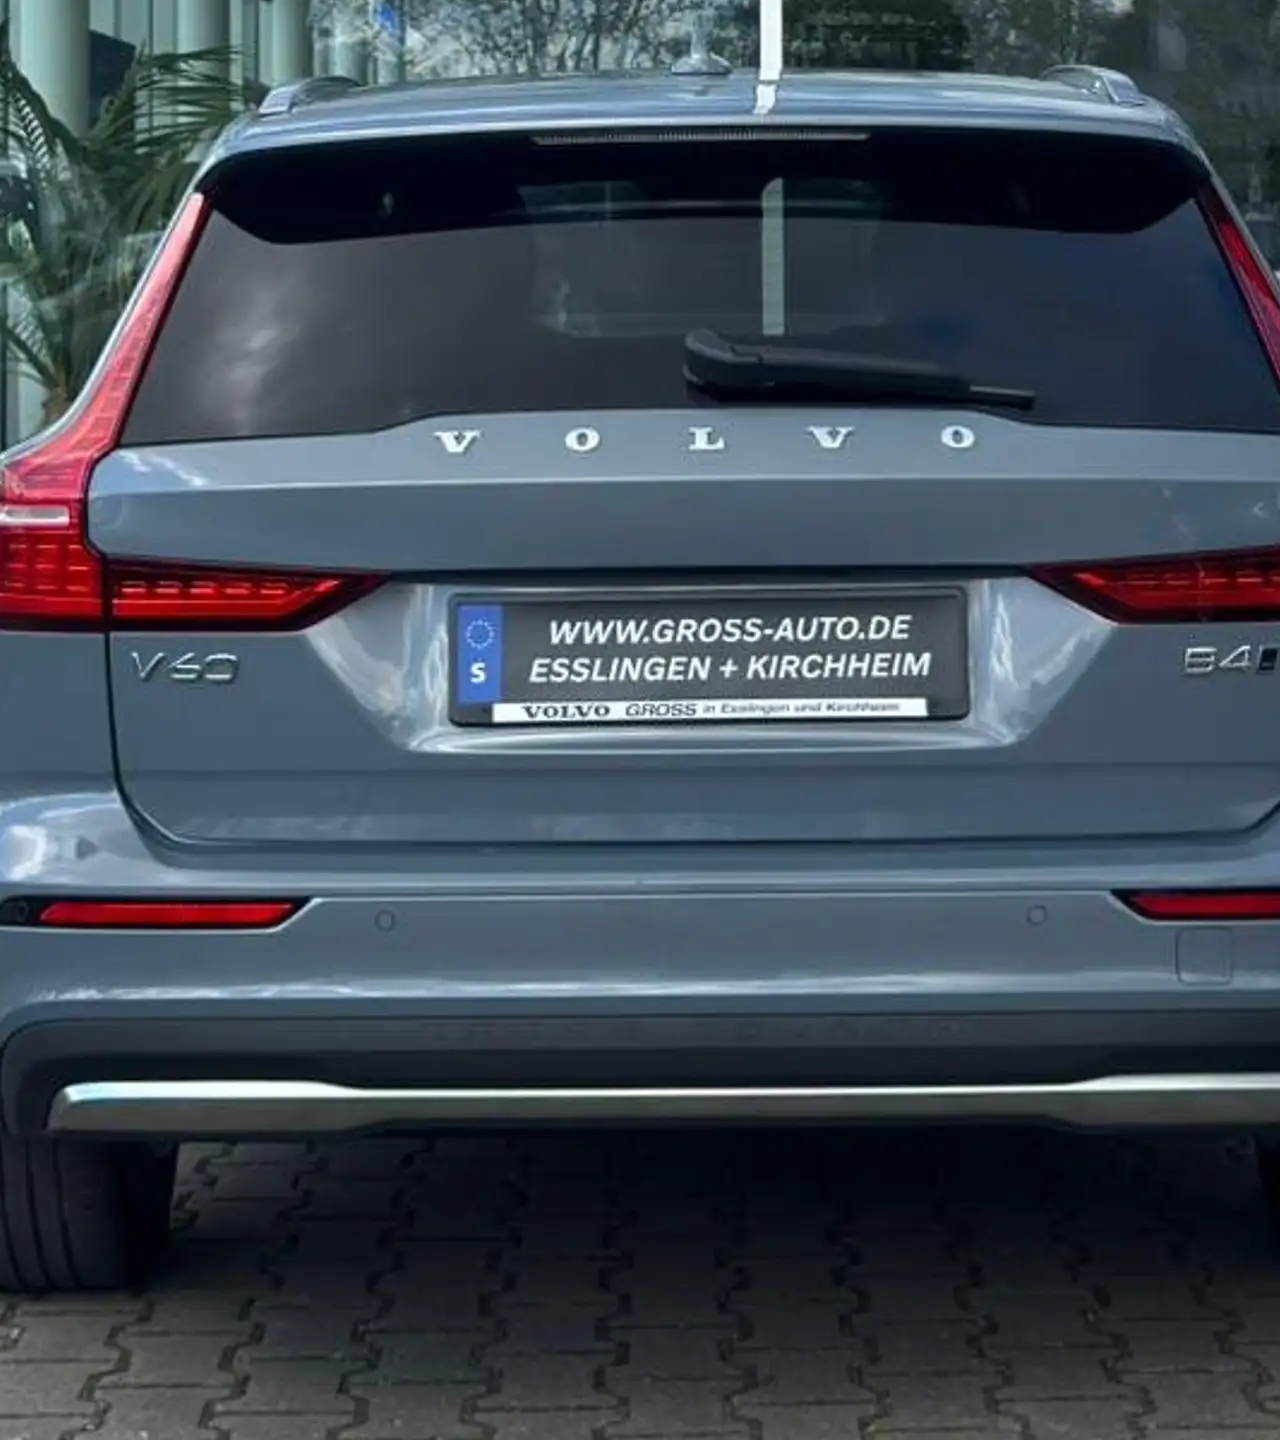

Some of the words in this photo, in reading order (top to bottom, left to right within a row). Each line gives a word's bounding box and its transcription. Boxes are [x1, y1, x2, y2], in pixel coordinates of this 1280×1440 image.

[434, 424, 977, 454] VOLVO
[549, 614, 913, 646] WWW.GROSS-AUTO.DE
[131, 651, 240, 680] V60
[470, 662, 487, 684] S
[528, 655, 711, 683] ESSLINGEN
[719, 658, 737, 679] +
[746, 652, 932, 681] KIRCHHEIM
[523, 704, 611, 719] VOLVO
[624, 702, 698, 717] GROSS
[721, 702, 790, 715] Esslingen
[825, 701, 901, 713] Kirchheim
